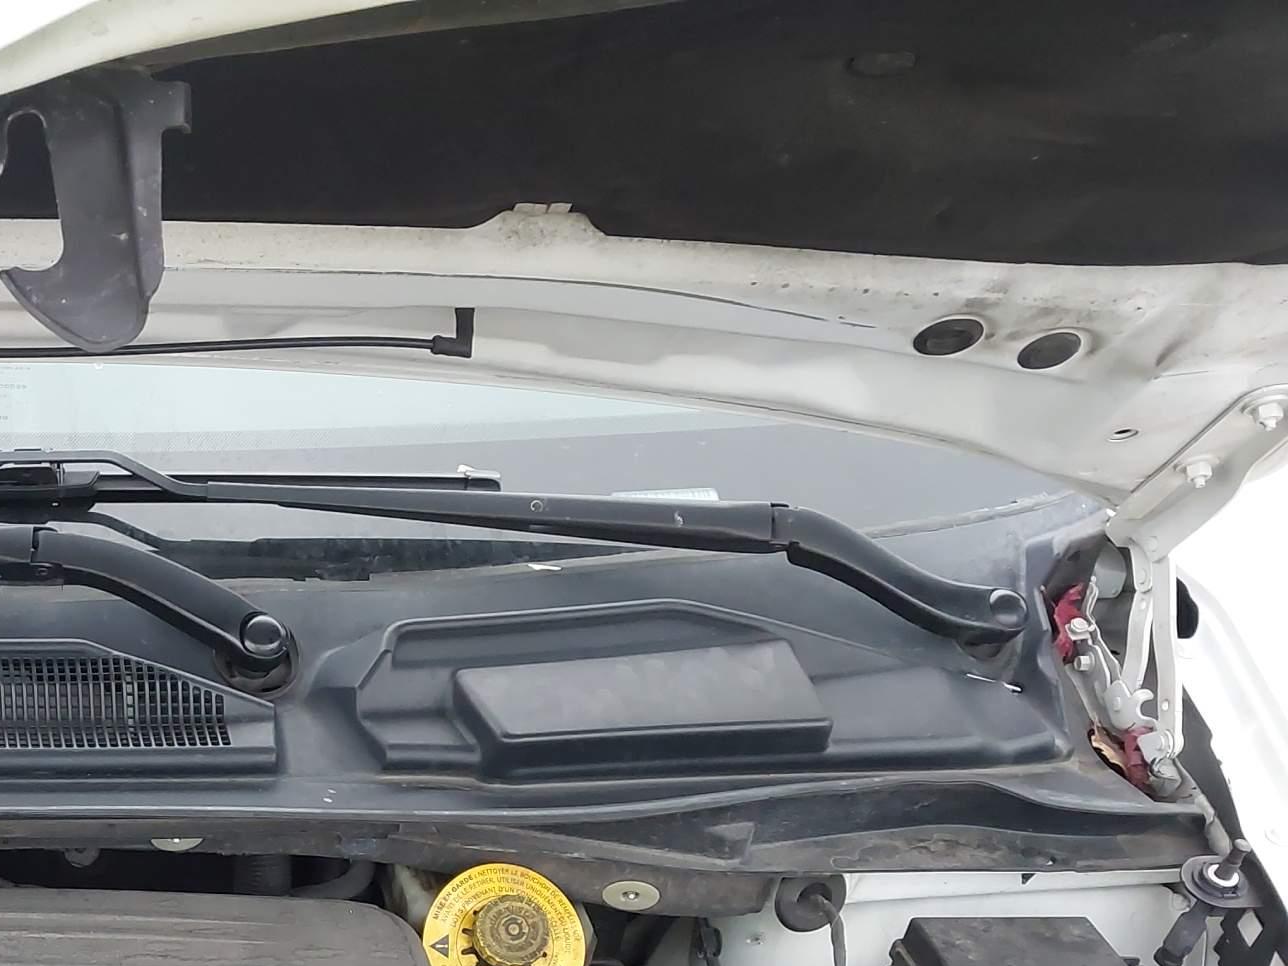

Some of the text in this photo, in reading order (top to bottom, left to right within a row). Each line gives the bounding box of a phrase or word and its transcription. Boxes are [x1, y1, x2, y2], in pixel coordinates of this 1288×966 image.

[431, 900, 445, 919] MISE
[441, 890, 452, 902] EN
[449, 874, 473, 893] GARDE
